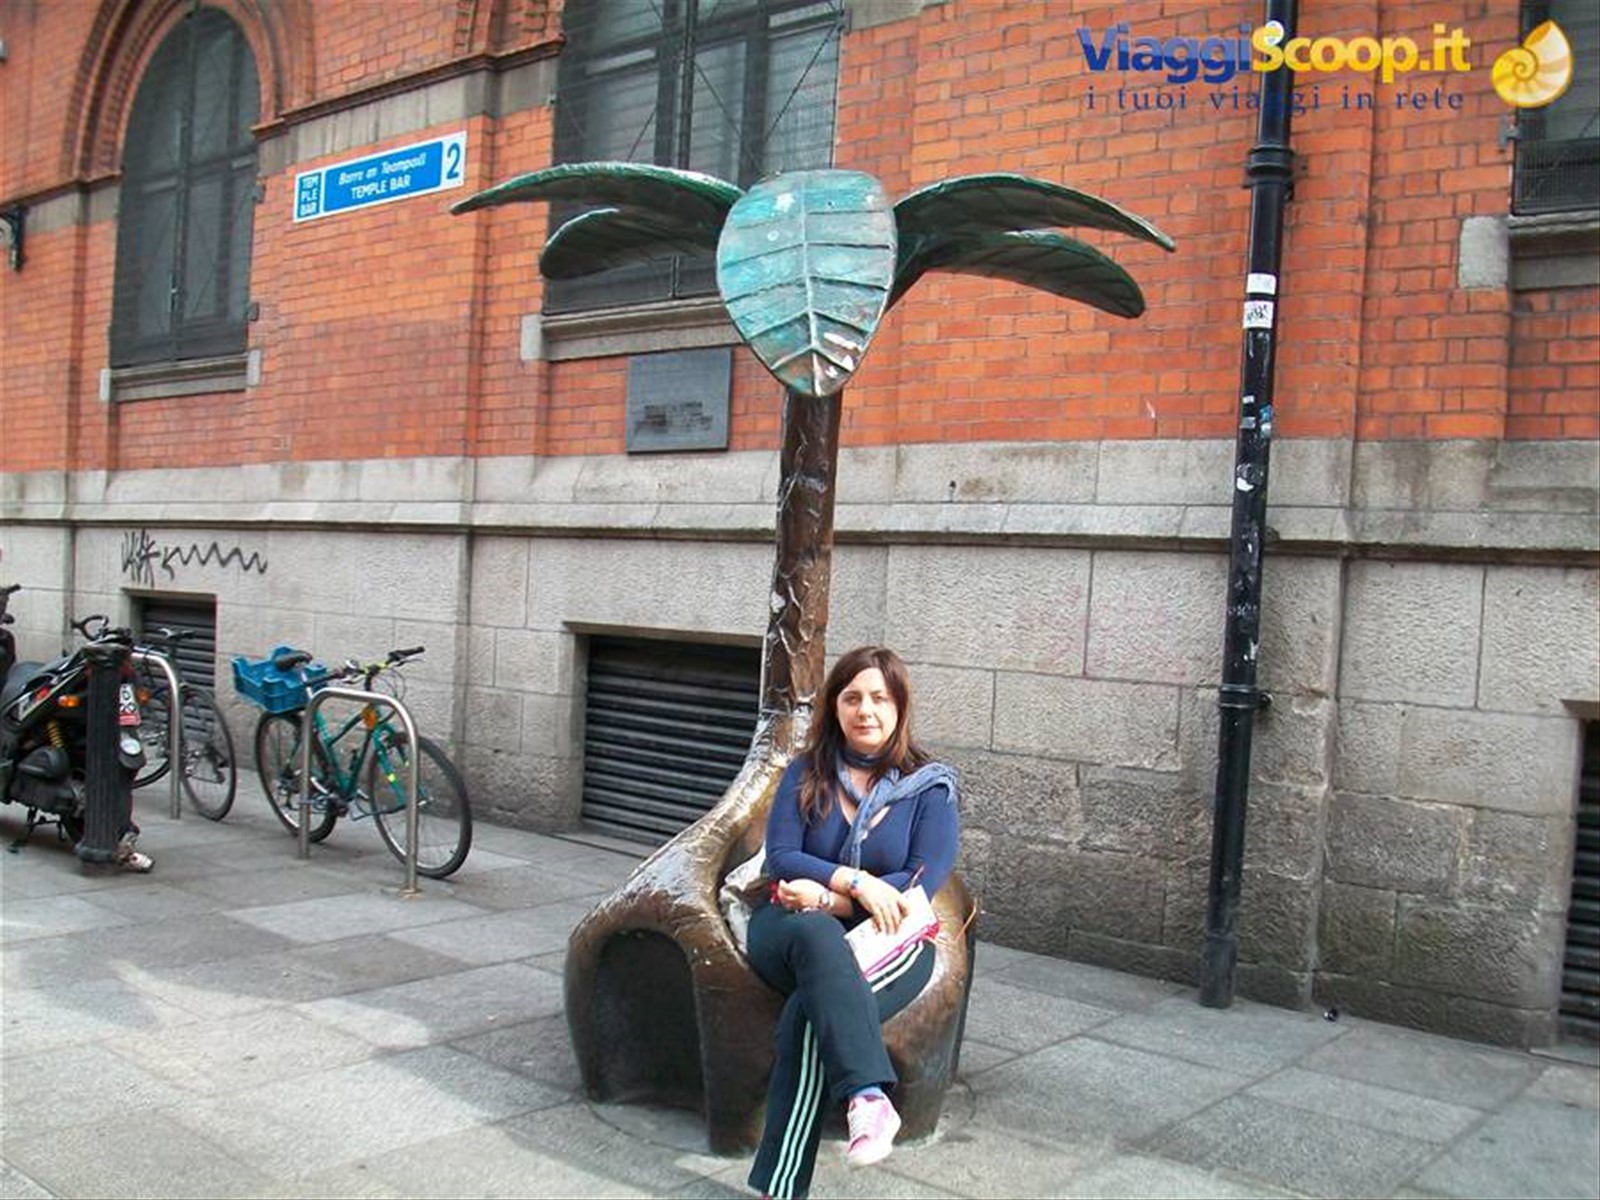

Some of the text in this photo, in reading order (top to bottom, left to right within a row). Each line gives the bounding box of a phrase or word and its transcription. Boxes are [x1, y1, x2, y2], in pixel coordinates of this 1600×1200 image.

[446, 142, 461, 180] 2
[301, 188, 318, 202] PLE
[351, 174, 411, 199] TEMPLE BAR
[300, 202, 317, 216] BAR
